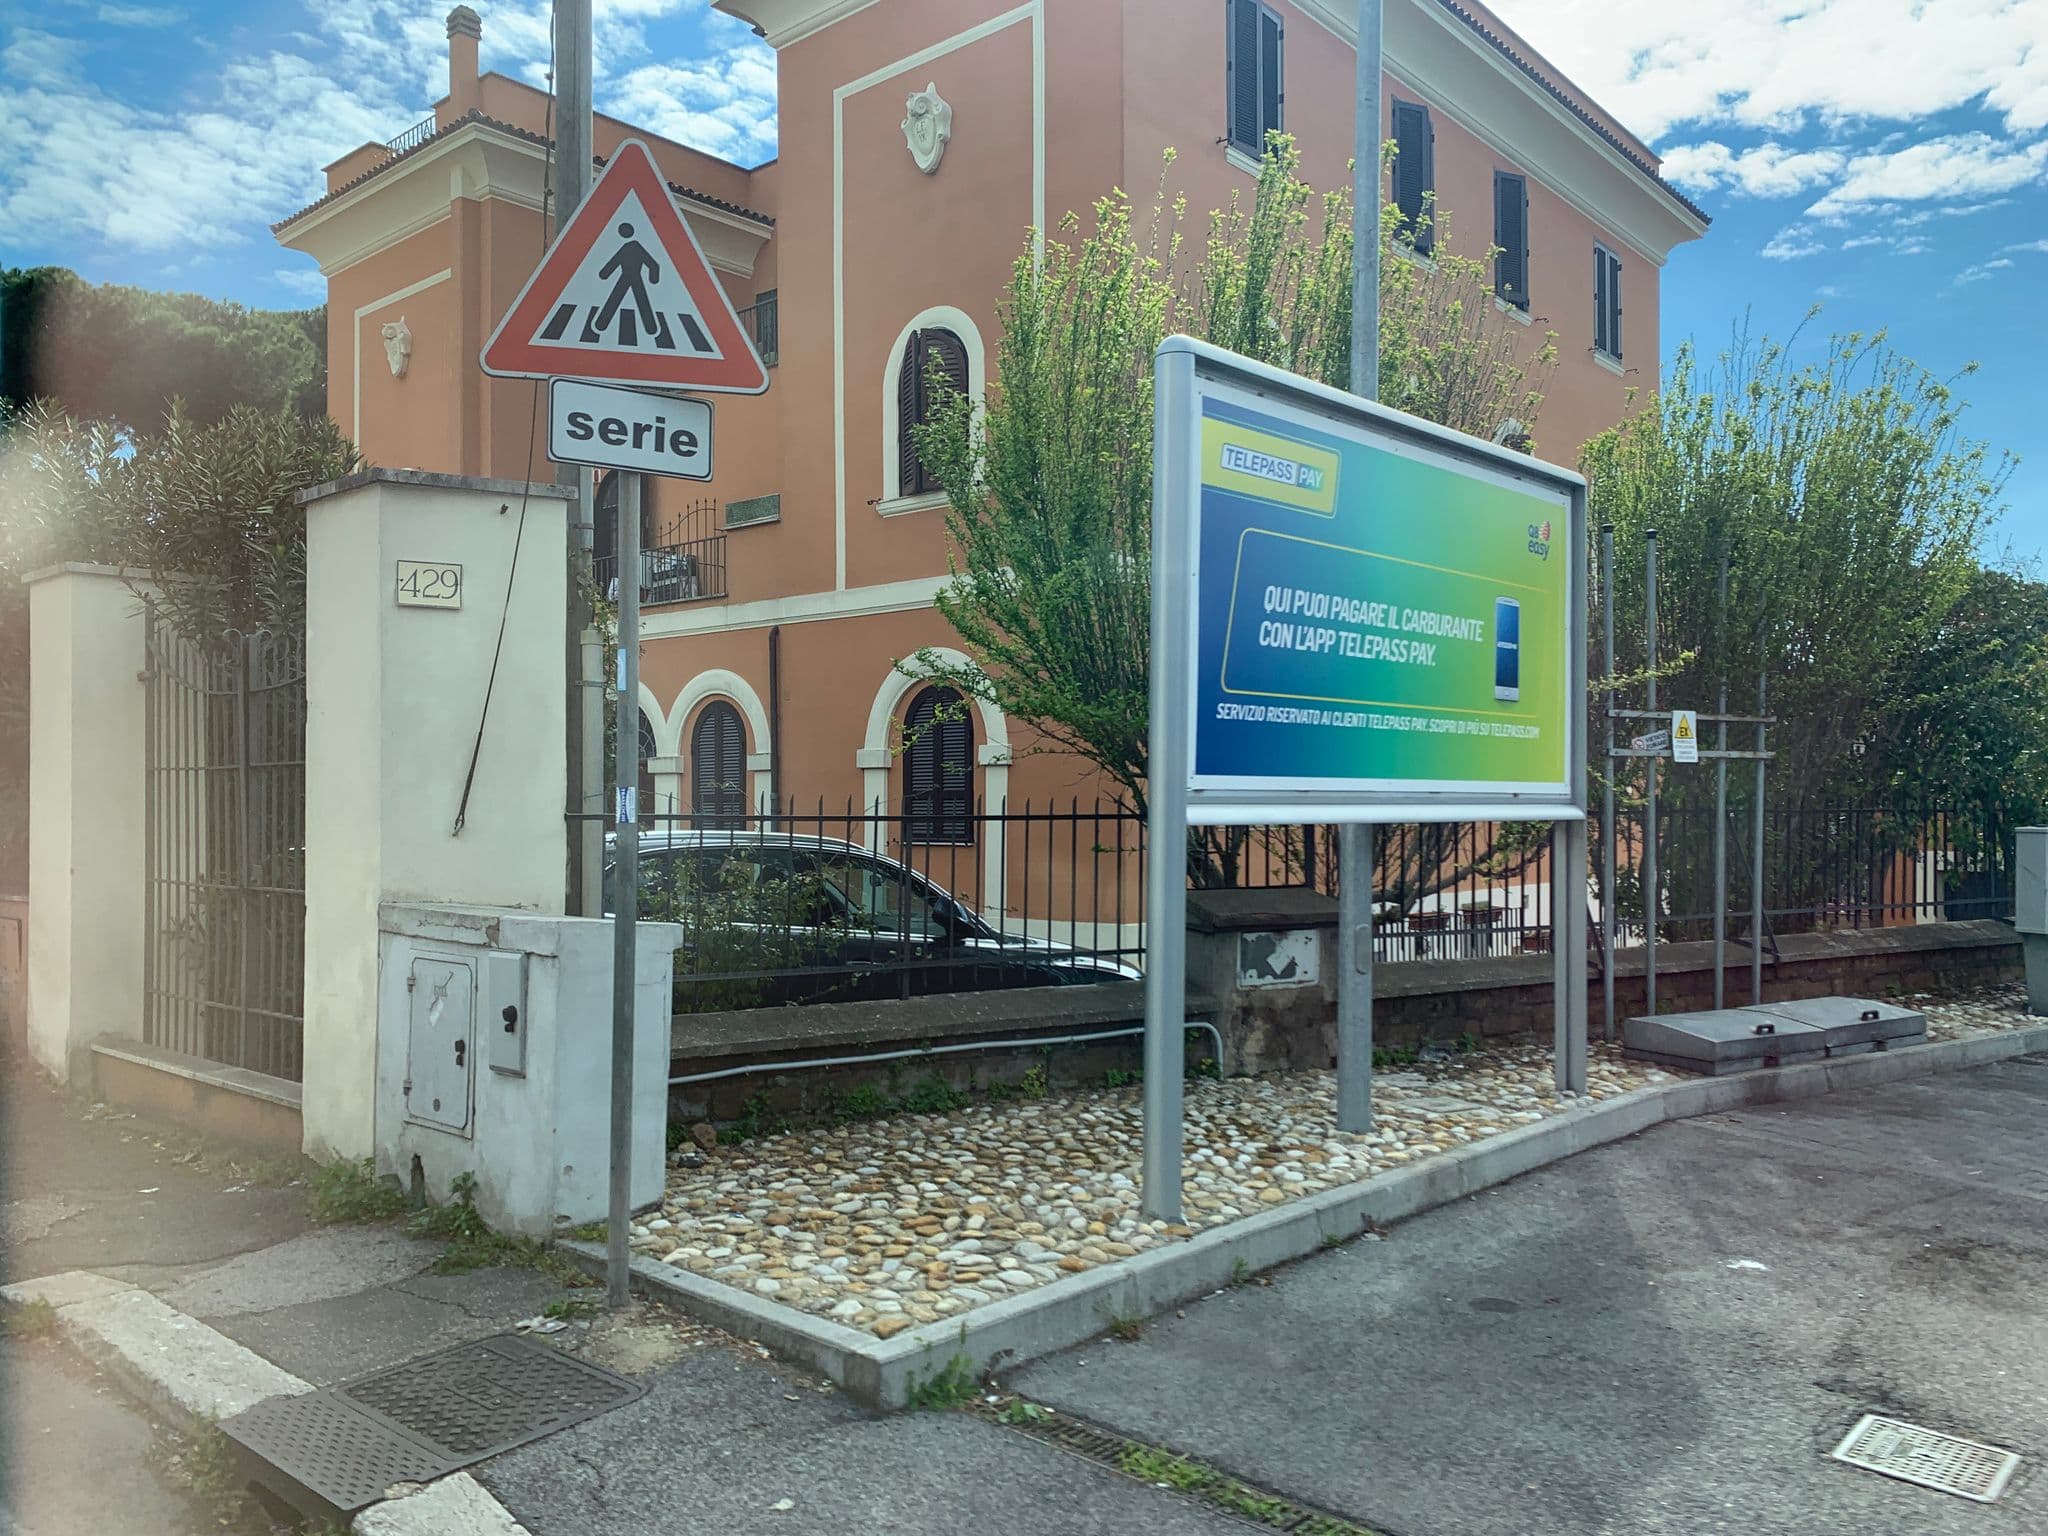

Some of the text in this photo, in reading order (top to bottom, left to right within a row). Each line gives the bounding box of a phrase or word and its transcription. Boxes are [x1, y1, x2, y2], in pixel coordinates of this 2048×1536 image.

[566, 412, 698, 457] serie
[1225, 447, 1323, 489] TELEPASS PAY
[1528, 540, 1550, 561] easy
[400, 568, 459, 599] 429
[1263, 585, 1485, 643] QUI PUOI PAGARE IL CARBURANTE
[1259, 620, 1437, 667] CON L'APP TELEPASS PAY.
[1216, 702, 1265, 721] SERVIZIO
[1266, 706, 1321, 725] RISERVATO
[1320, 710, 1332, 726] AI
[1332, 711, 1367, 728] CLIENTI
[1368, 713, 1411, 731] TELEPASS
